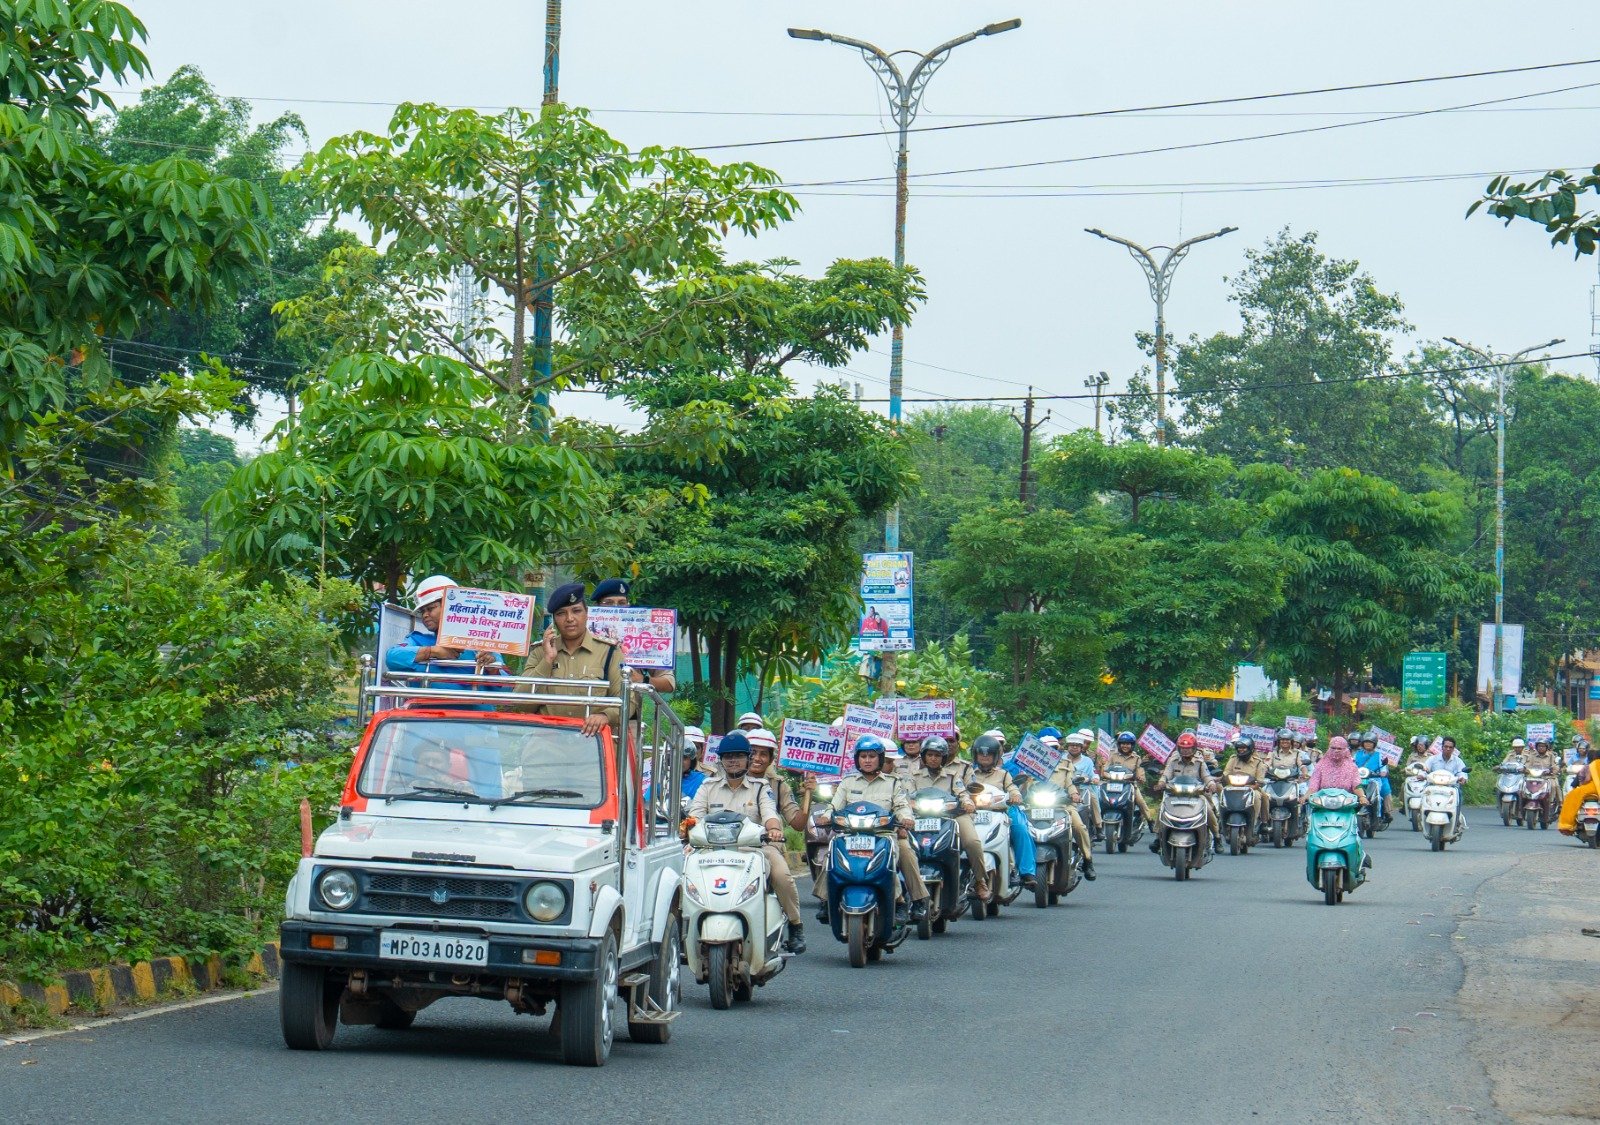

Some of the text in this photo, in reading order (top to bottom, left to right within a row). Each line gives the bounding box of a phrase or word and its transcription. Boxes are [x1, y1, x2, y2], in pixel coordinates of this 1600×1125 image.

[449, 602, 480, 615] महिलाओं
[480, 605, 487, 615] ने
[487, 607, 498, 618] यह
[499, 609, 516, 619] ठाना
[446, 613, 469, 624] शोषण
[469, 615, 478, 625] के
[502, 620, 526, 631] आवाज
[468, 628, 490, 639] उठाना
[623, 631, 671, 651] शक्ति
[467, 639, 484, 648] पुलिस
[784, 735, 840, 753] सशक्त नारी
[787, 748, 816, 761] सशक्त
[816, 752, 842, 766] समाज
